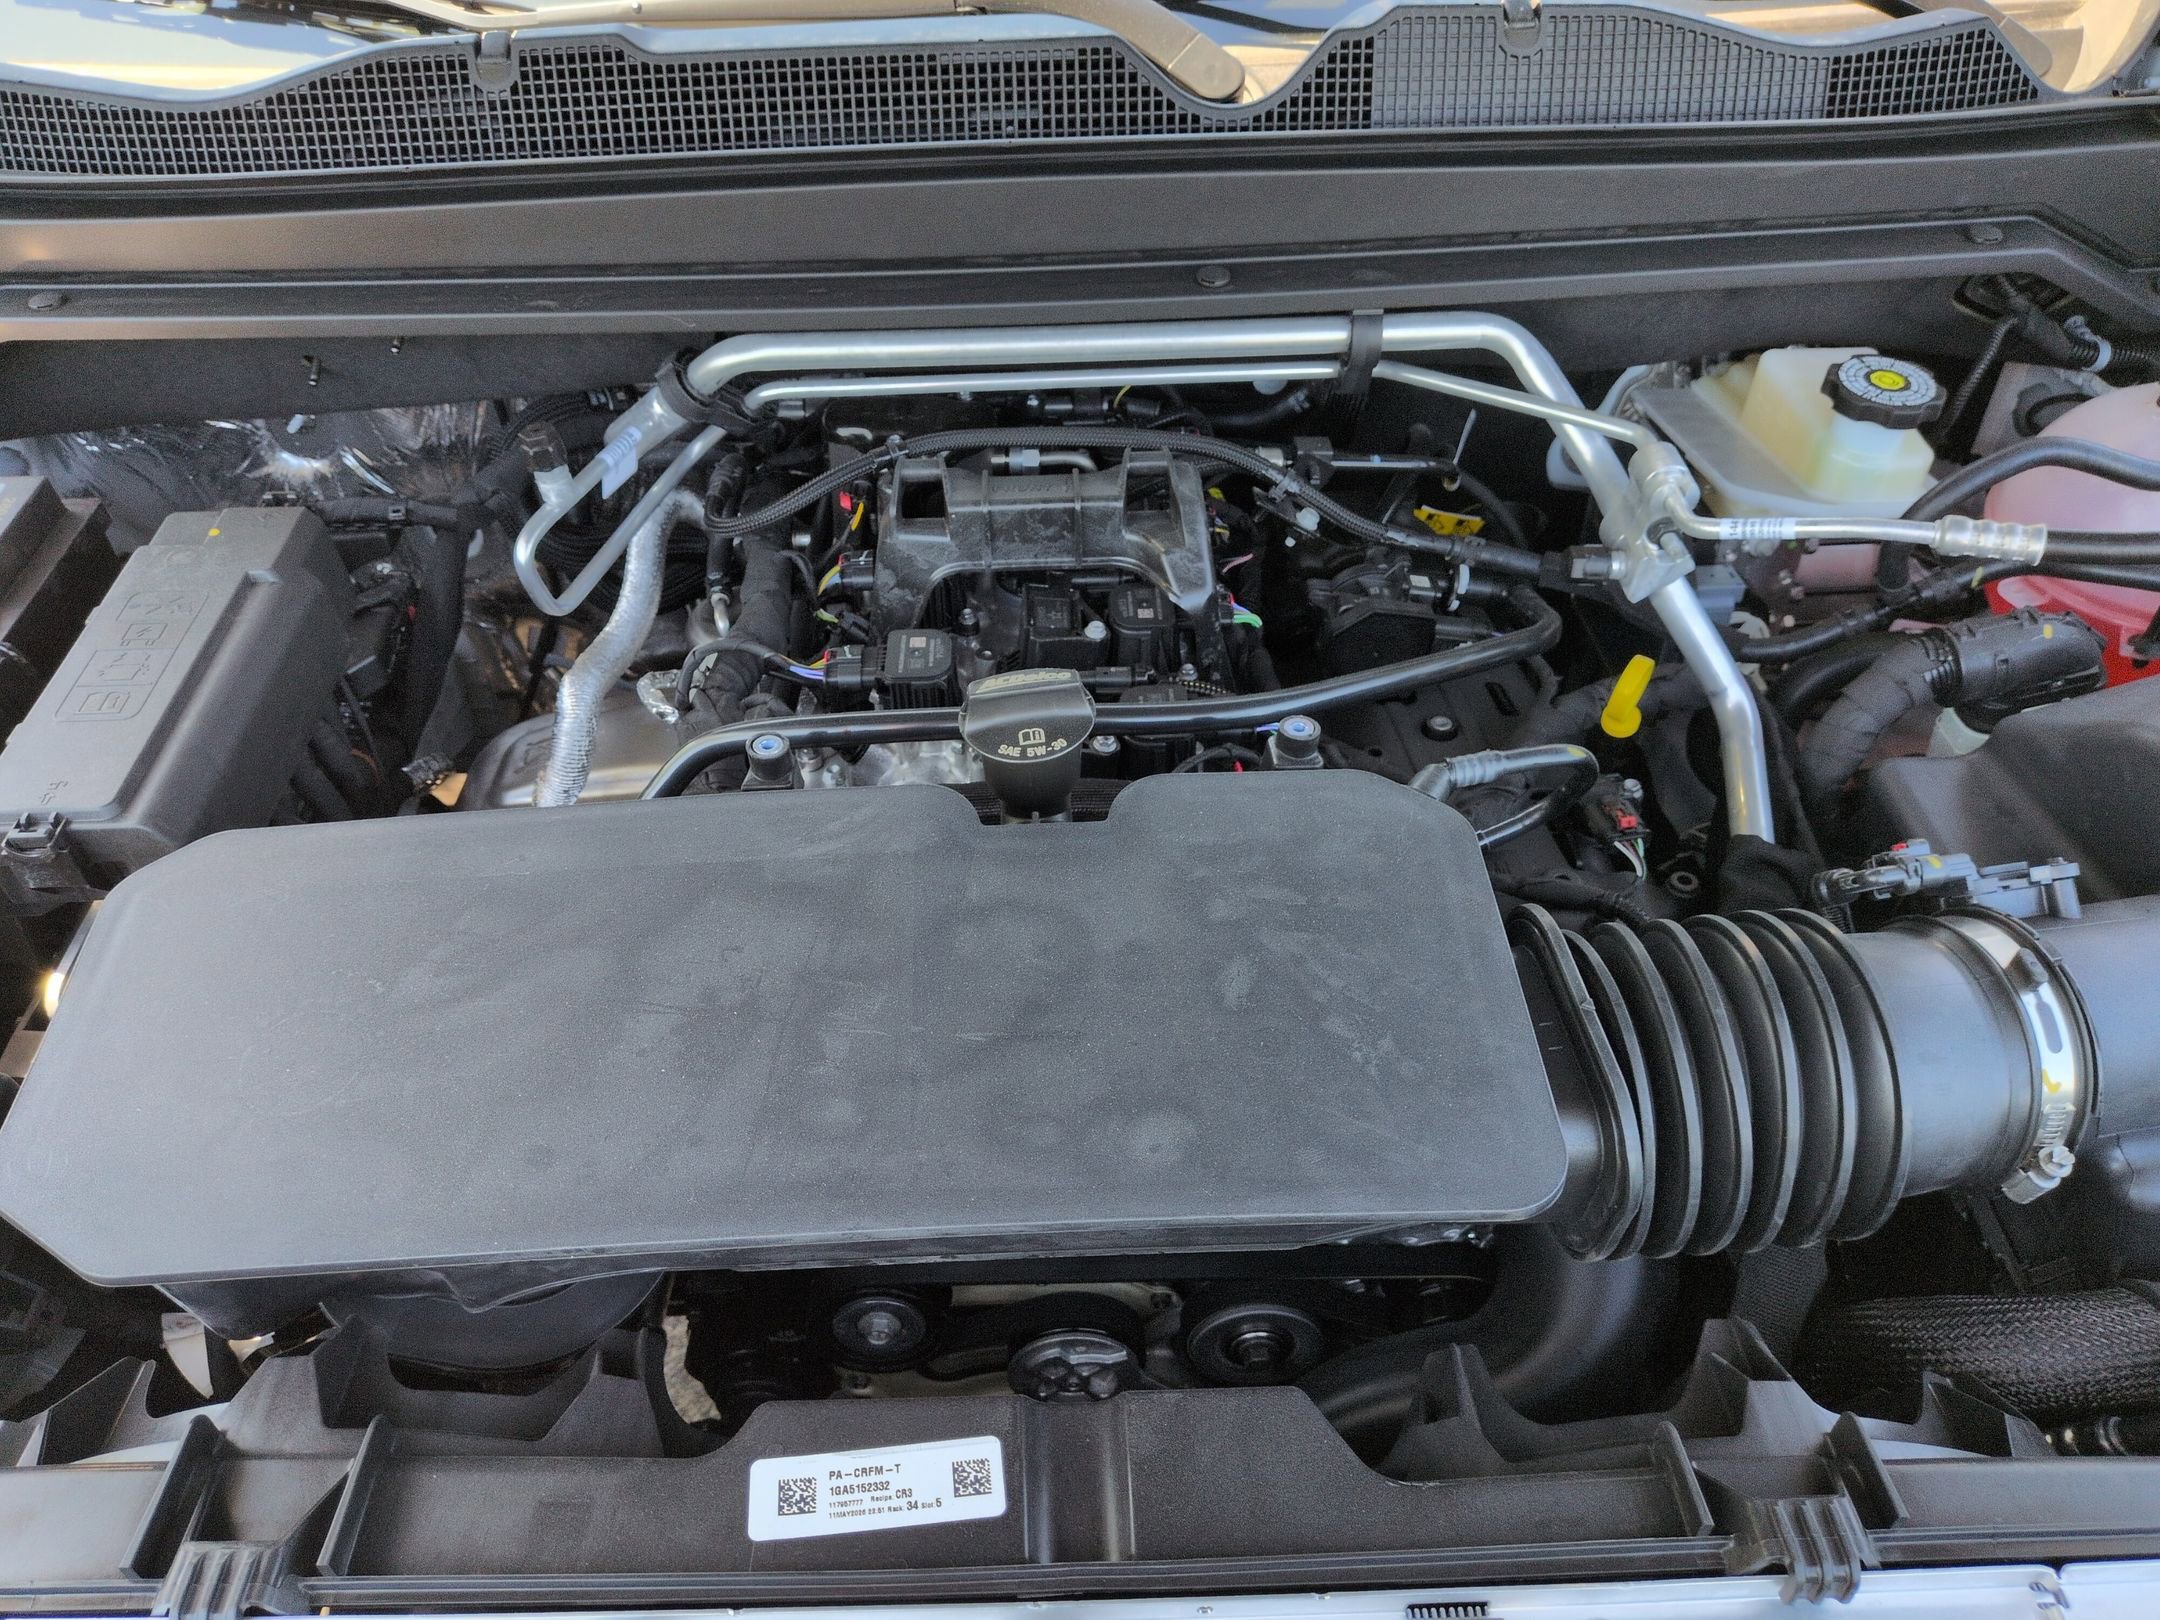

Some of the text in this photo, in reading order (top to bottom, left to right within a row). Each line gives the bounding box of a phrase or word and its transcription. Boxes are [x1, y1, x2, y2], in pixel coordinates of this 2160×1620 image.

[978, 671, 1072, 689] ACDelco
[997, 738, 1068, 757] SAE 5W-30
[828, 1463, 901, 1480] PA-CRFM-T
[829, 1480, 890, 1496] 1GA5152332
[895, 1488, 913, 1499] CR3
[906, 1499, 919, 1511] 34
[935, 1497, 942, 1508] 5
